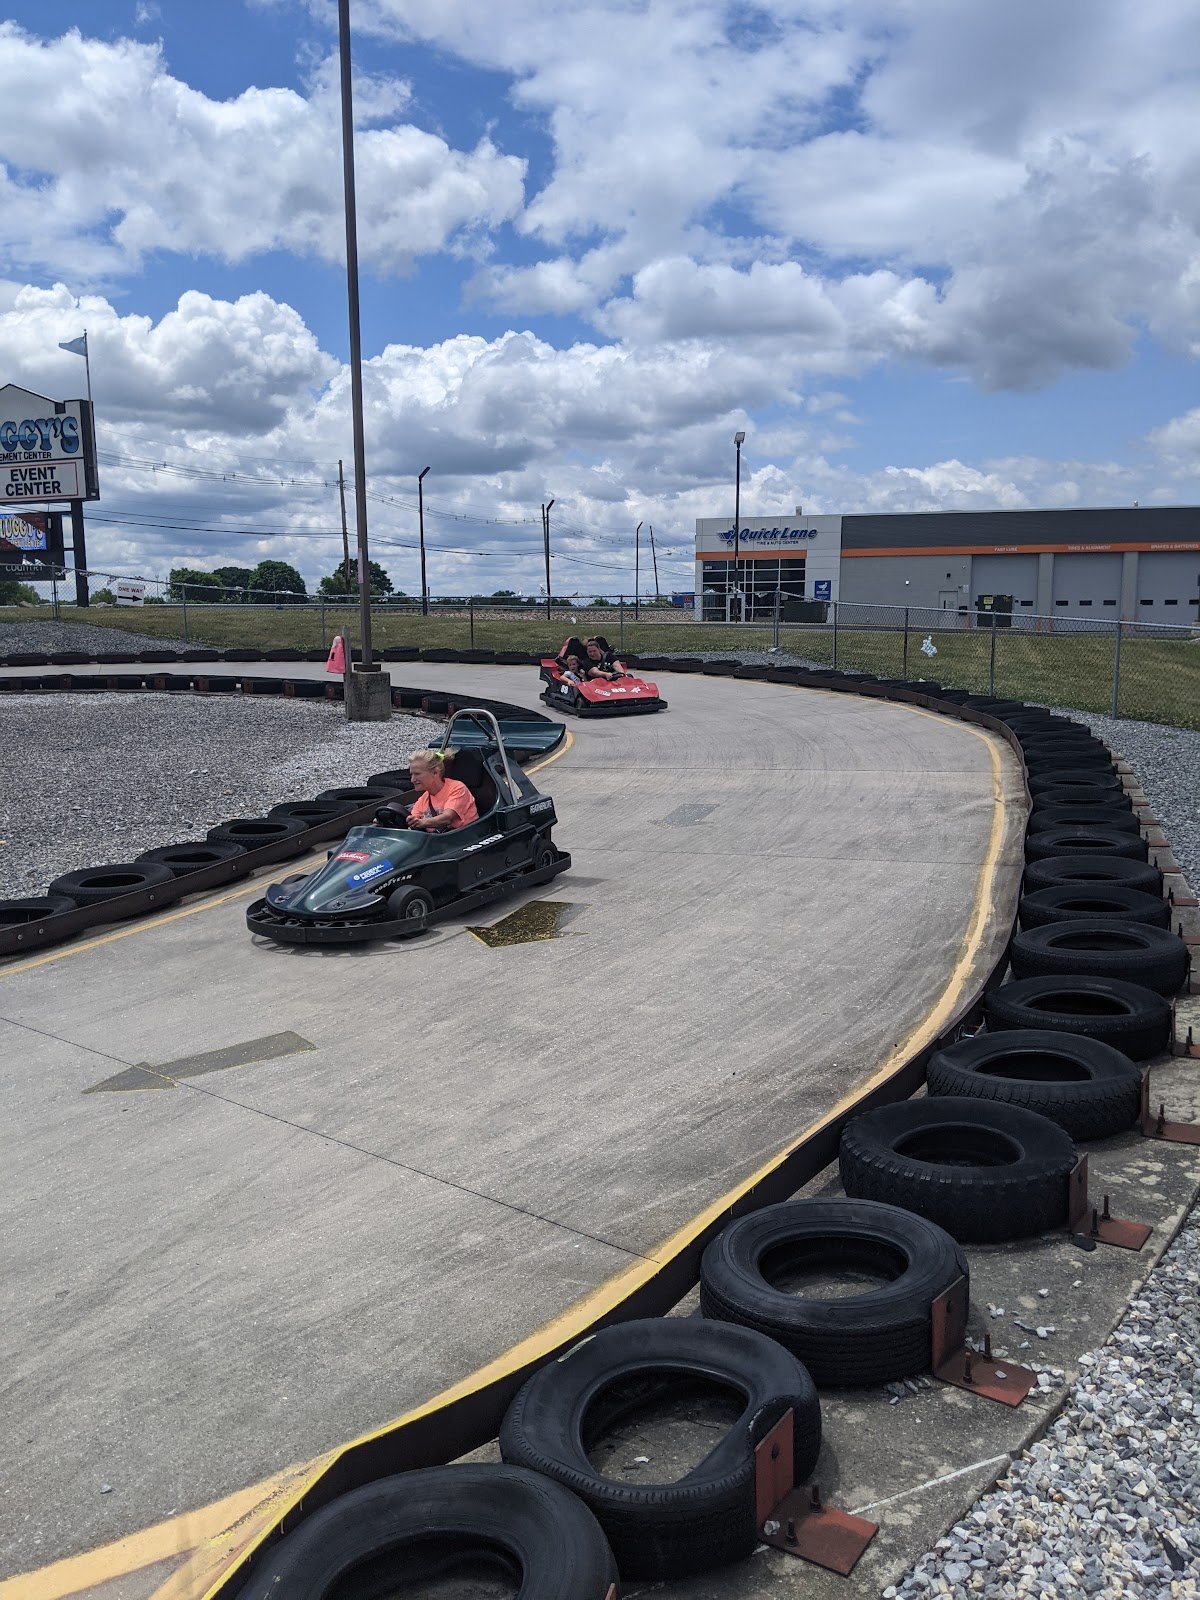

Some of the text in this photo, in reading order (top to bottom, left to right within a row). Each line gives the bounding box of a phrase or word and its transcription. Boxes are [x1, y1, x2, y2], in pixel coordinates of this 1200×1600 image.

[24, 451, 51, 460] CENTER
[10, 466, 56, 482] EVENT
[5, 481, 61, 496] CENTER
[739, 527, 817, 541] Quick Lane
